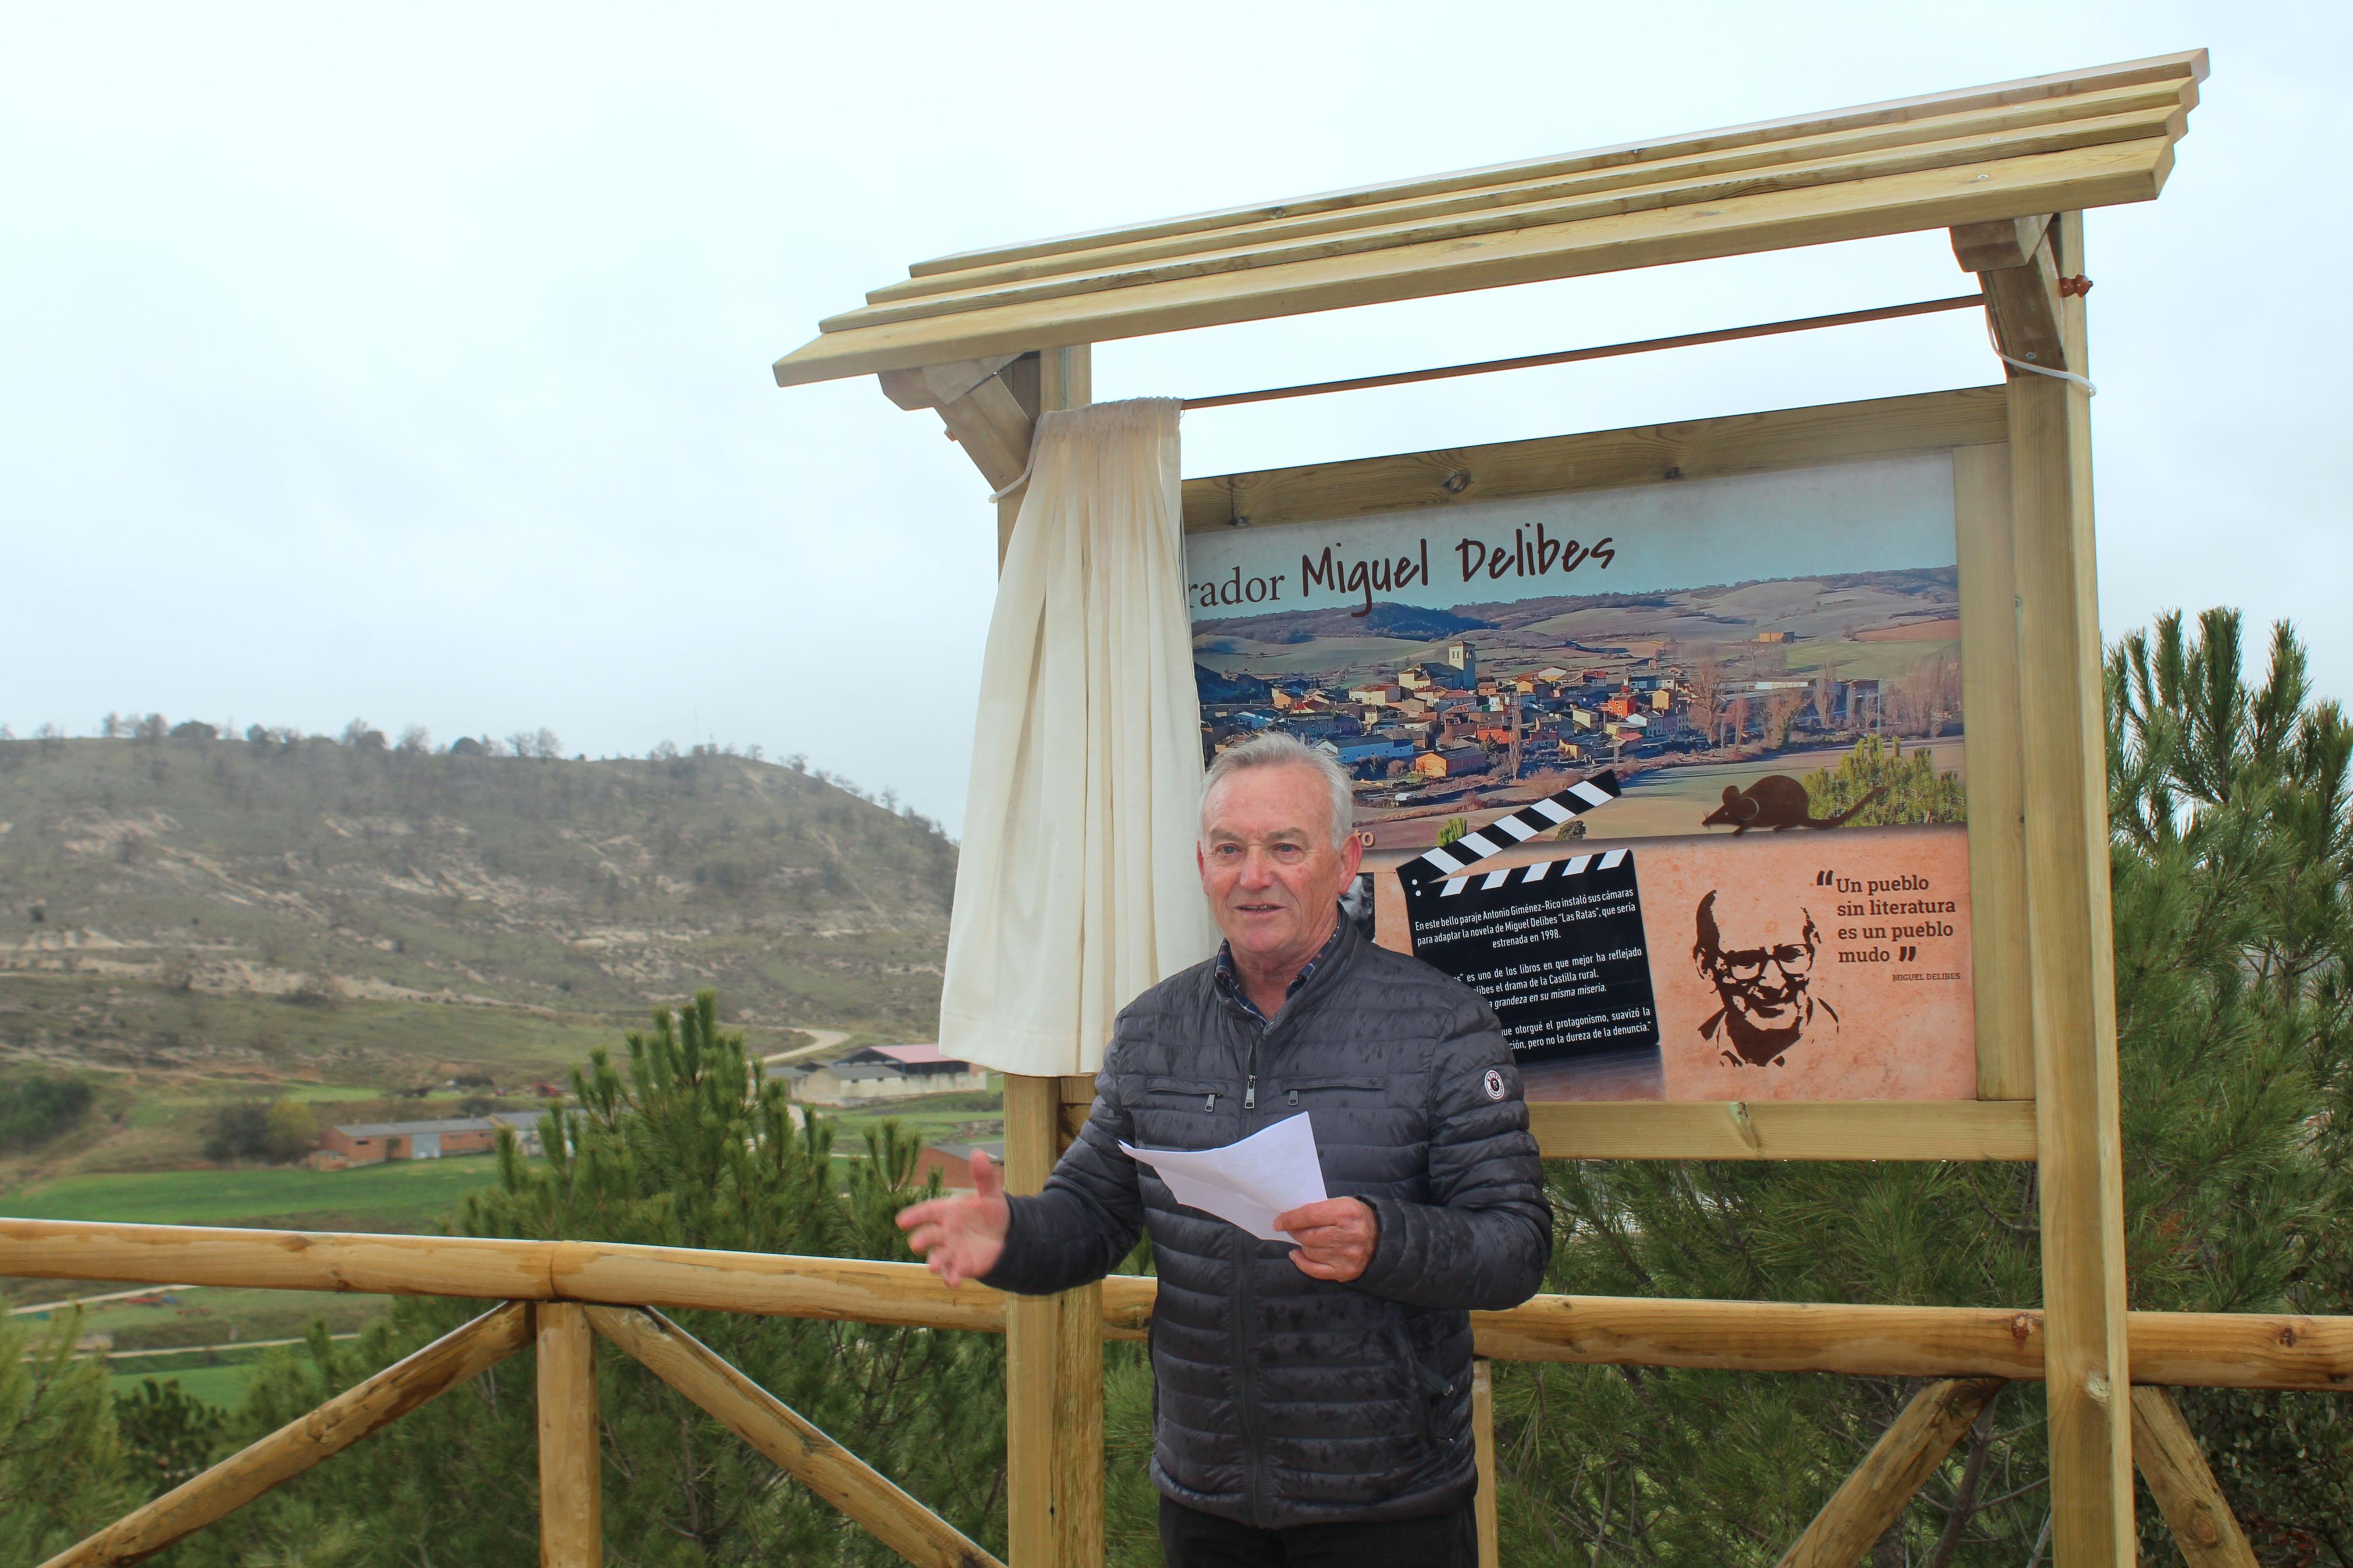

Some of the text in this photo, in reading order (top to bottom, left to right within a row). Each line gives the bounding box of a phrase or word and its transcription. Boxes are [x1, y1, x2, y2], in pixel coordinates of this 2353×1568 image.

[1301, 538, 1427, 618] Miguel
[1455, 522, 1616, 582] Delibes
[1867, 874, 1929, 896] pueblo
[1415, 889, 1634, 931] En este bello paraje Antonio Giménez-Rico instaló sus cámaras
[1837, 899, 1956, 916] sin literatura
[1417, 937, 1433, 947] para
[1434, 931, 1461, 943] adaptar
[1462, 929, 1470, 938] la
[1471, 925, 1494, 937] novela
[1495, 924, 1504, 933] de
[1505, 919, 1530, 933] Miguel
[1531, 916, 1558, 927] Delibes
[1602, 908, 1616, 918] que
[1617, 902, 1635, 913] sería
[1837, 921, 1953, 942] es un pueblo
[1492, 929, 1561, 948] estrenada en 1998.
[1467, 974, 1475, 982] es
[1478, 971, 1491, 980] uno
[1494, 968, 1503, 978] de
[1506, 966, 1517, 976] los
[1520, 963, 1541, 974] libros
[1543, 962, 1553, 970] en
[1556, 960, 1569, 970] que
[1572, 955, 1593, 966] mejor
[1596, 952, 1606, 962] ha
[1609, 947, 1642, 960] reflejado
[1474, 968, 1599, 995] libes el drama de la Castilla rural.
[1495, 995, 1527, 1009] grandeza
[1529, 994, 1538, 1002] en
[1540, 993, 1549, 1001] su
[1551, 989, 1575, 1000] misma
[1577, 983, 1607, 995] miseria.
[1515, 1021, 1543, 1034] otorgué
[1546, 1020, 1553, 1030] el
[1556, 1014, 1609, 1030] protagonismo,
[1612, 1007, 1639, 1021] suavizó
[1642, 1007, 1651, 1016] la
[1528, 1039, 1544, 1050] pero
[1546, 1037, 1555, 1045] no
[1557, 1034, 1564, 1043] la
[1566, 1032, 1591, 1042] dureza
[1593, 1029, 1602, 1039] de
[1603, 1027, 1611, 1037] la
